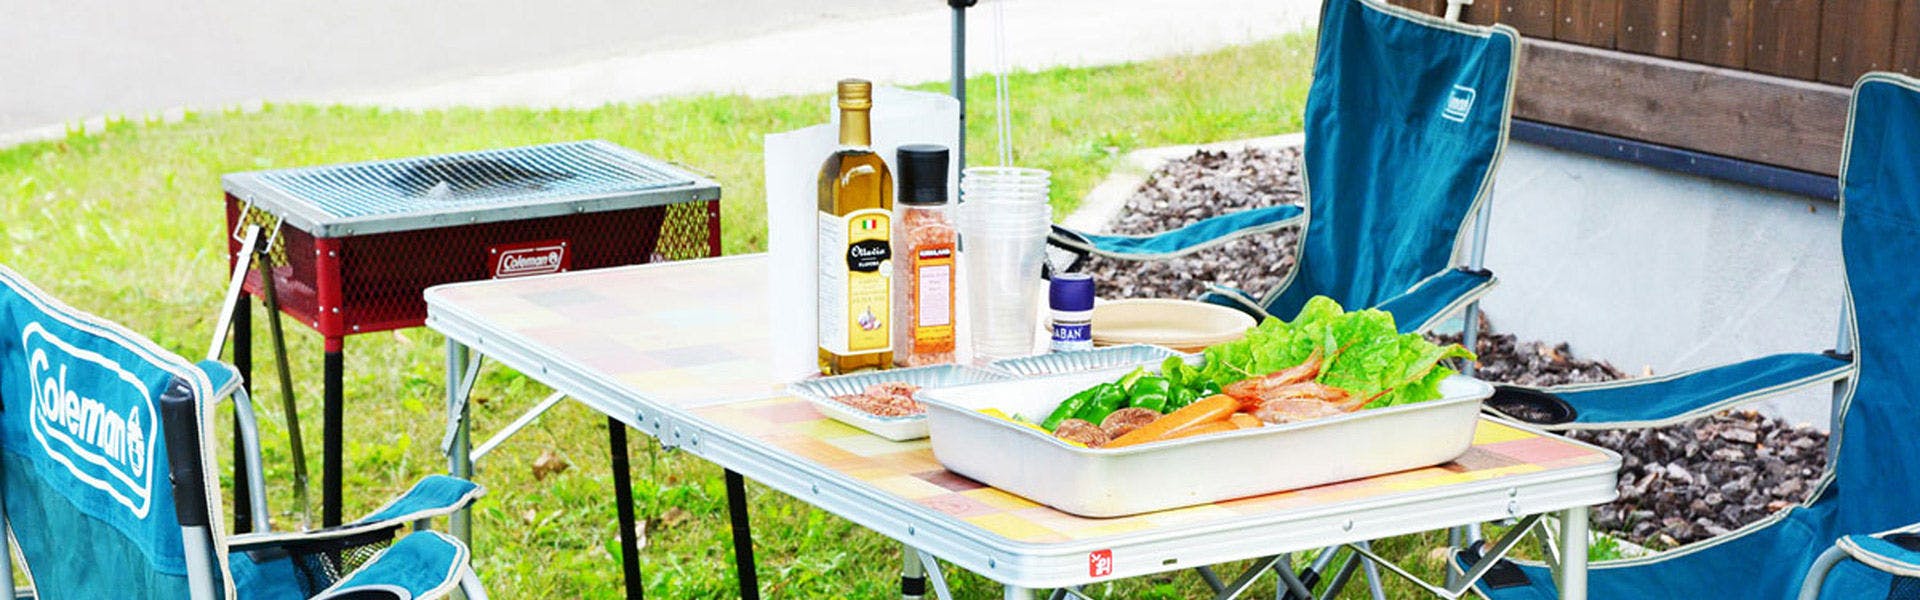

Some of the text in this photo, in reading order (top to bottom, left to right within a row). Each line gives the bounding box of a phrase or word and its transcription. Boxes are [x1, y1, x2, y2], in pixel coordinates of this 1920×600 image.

[503, 254, 549, 270] Coleman
[1053, 327, 1082, 339] ABAN
[31, 347, 127, 466] Coleman
